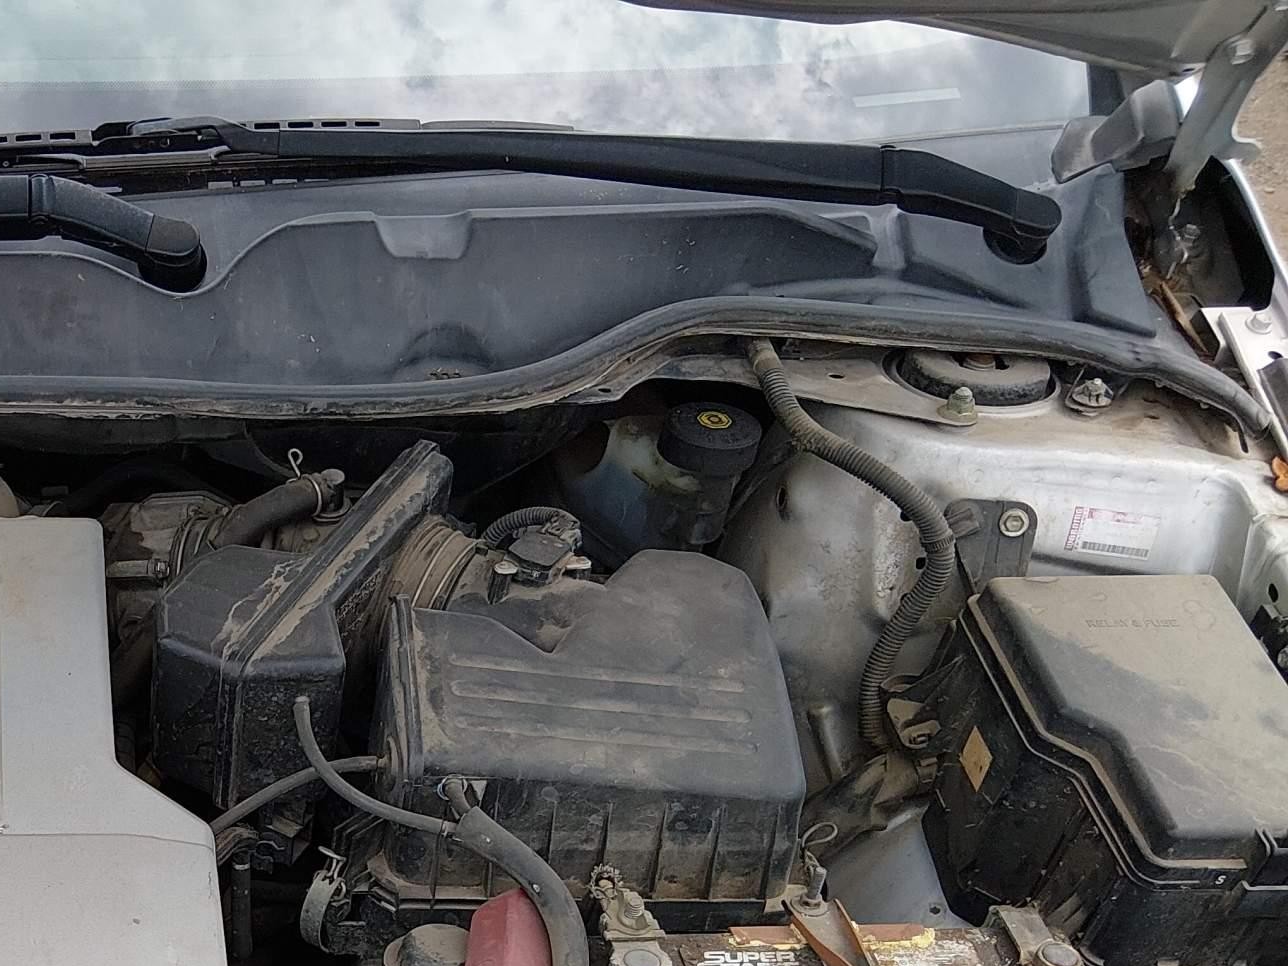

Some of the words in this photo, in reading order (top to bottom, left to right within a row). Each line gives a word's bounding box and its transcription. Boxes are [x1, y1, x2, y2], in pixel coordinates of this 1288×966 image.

[1144, 618, 1181, 629] FUSE
[1215, 874, 1227, 885] S
[703, 950, 797, 963] SUPER
